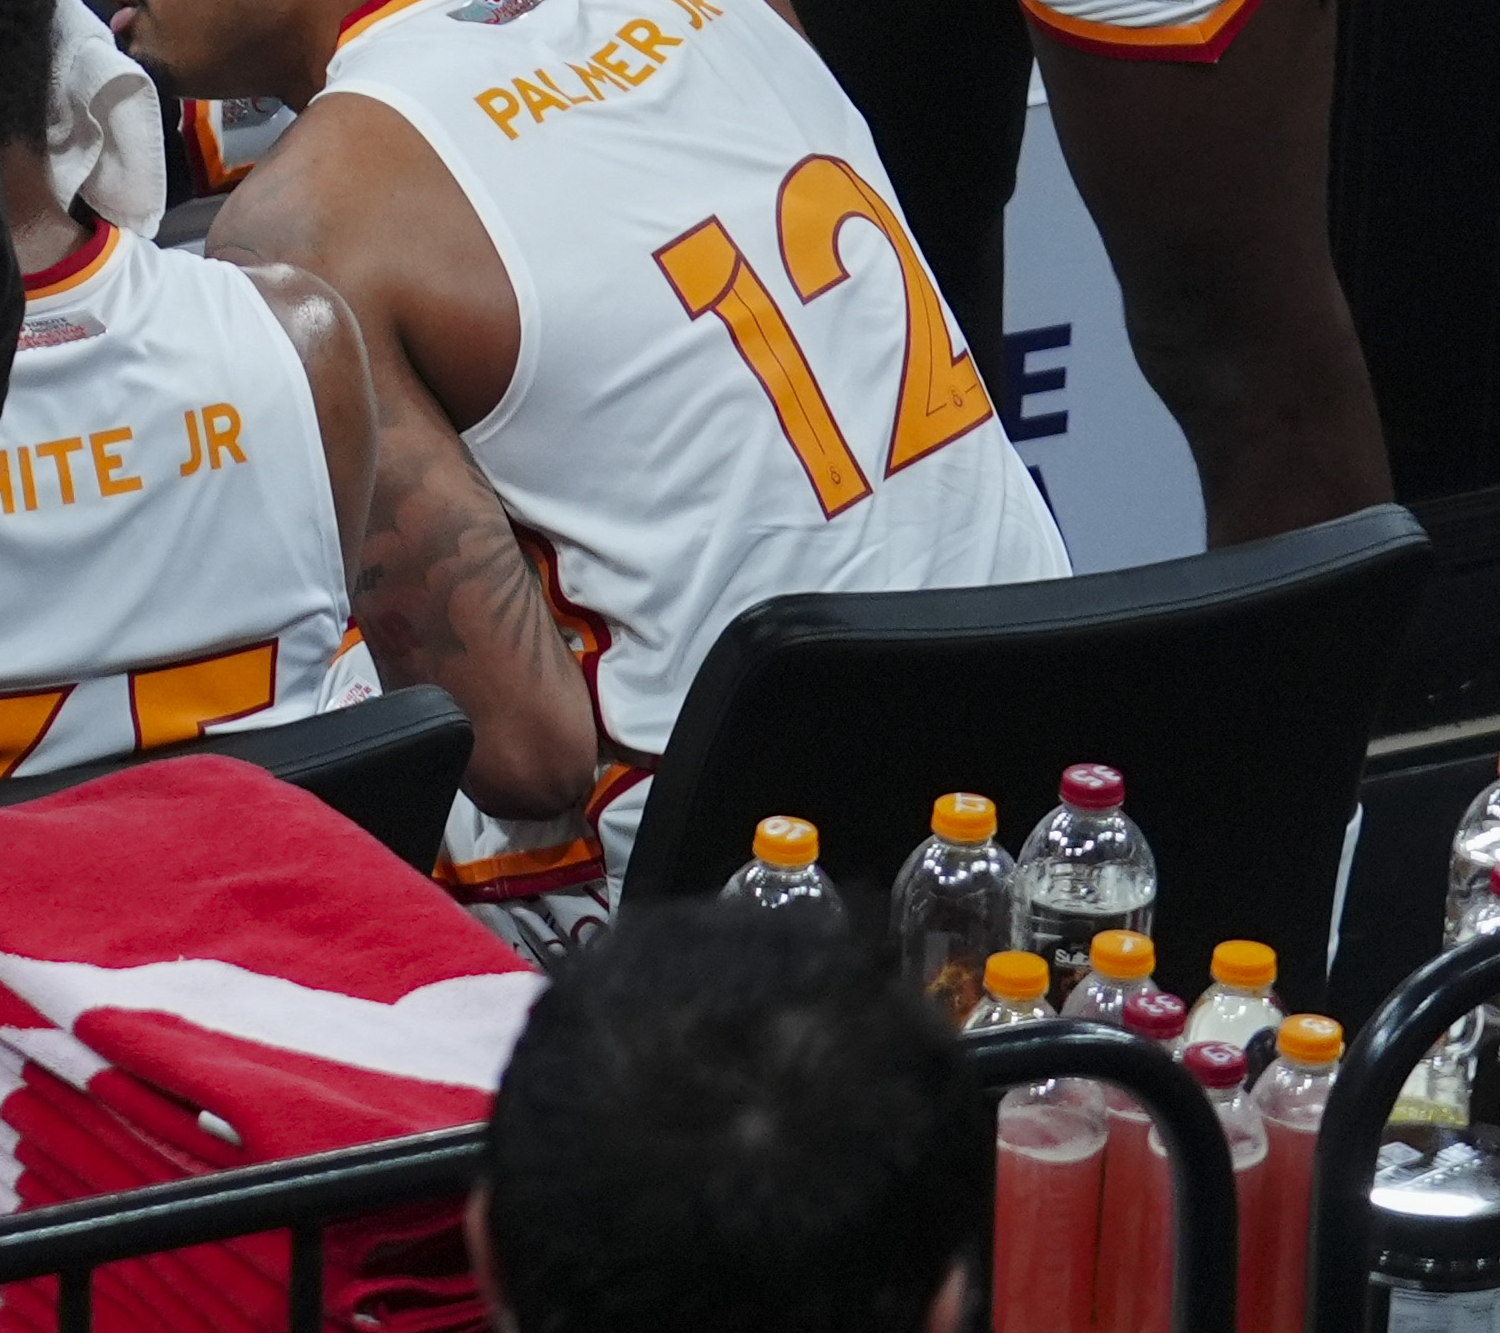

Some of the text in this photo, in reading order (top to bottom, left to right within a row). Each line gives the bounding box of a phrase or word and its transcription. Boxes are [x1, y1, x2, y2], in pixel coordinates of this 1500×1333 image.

[474, 18, 684, 141] PALMER
[652, 153, 994, 524] 12
[179, 402, 248, 477] JR
